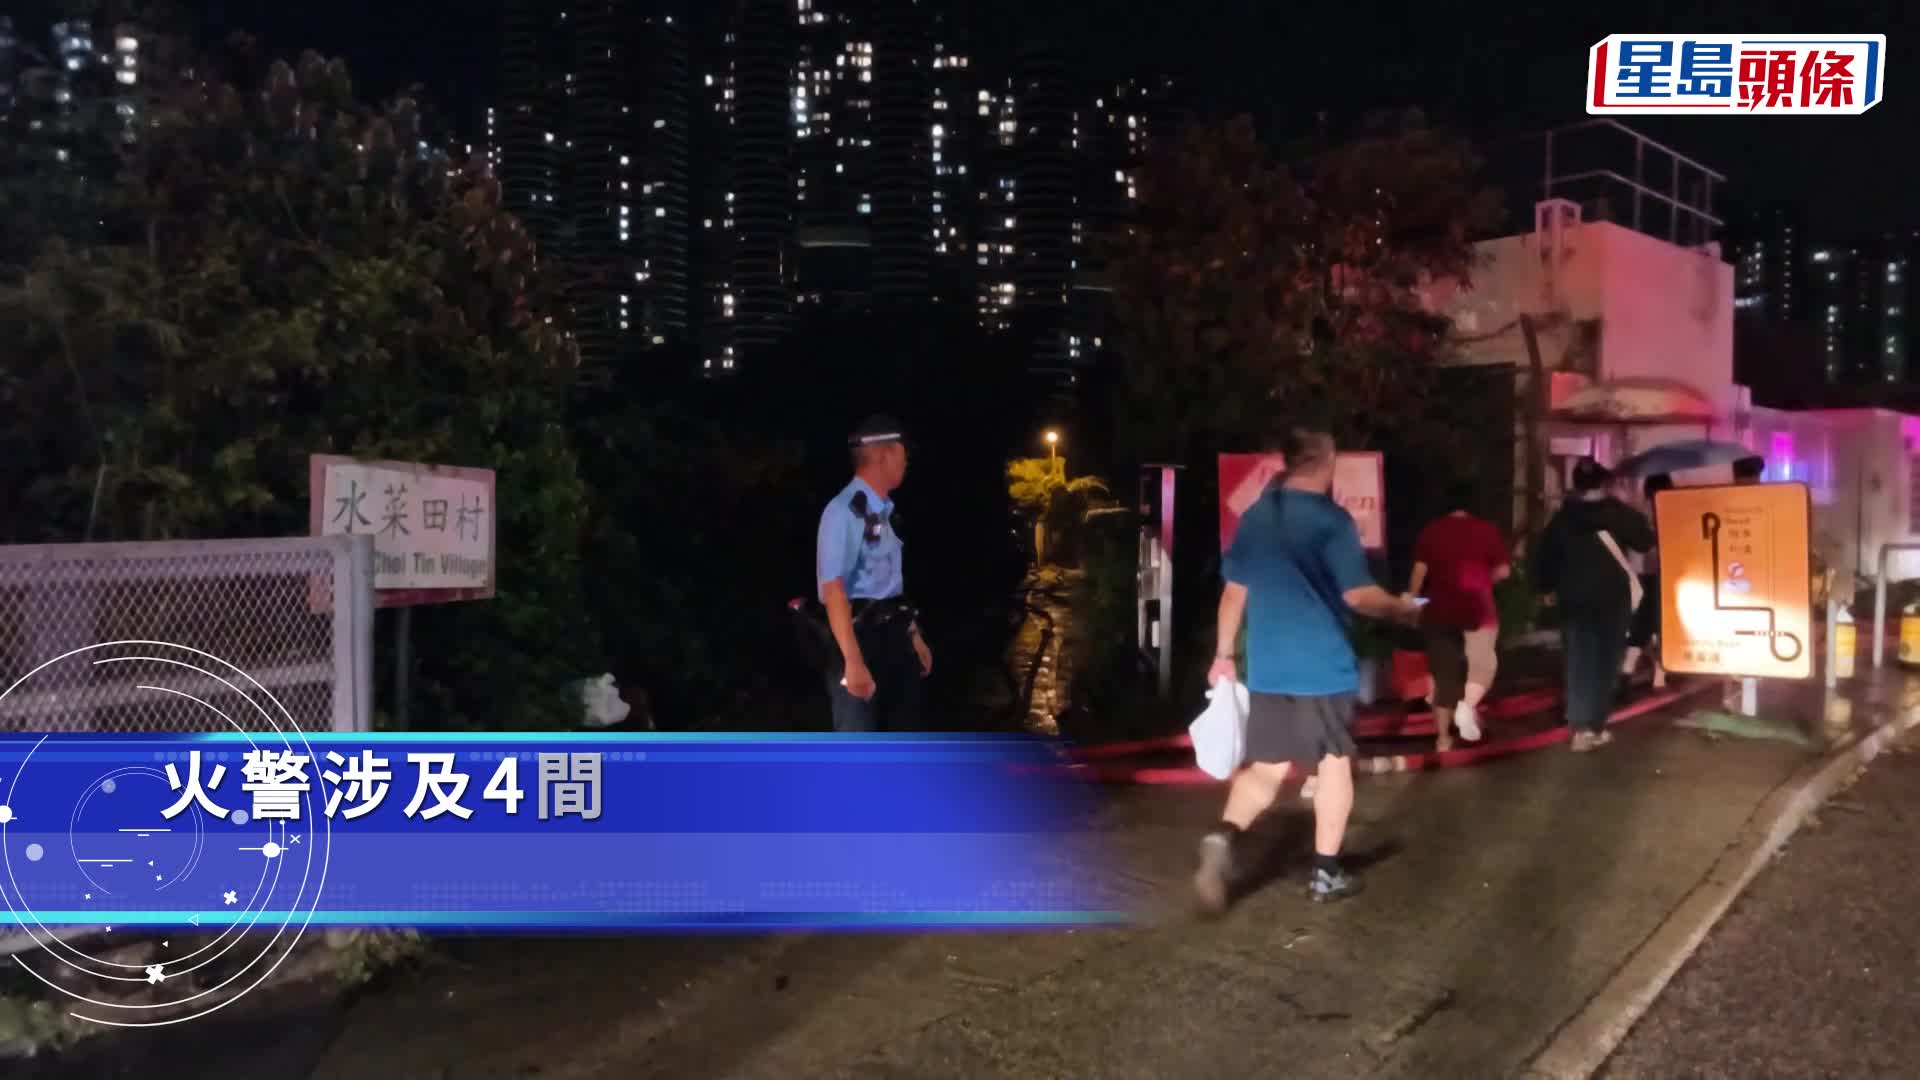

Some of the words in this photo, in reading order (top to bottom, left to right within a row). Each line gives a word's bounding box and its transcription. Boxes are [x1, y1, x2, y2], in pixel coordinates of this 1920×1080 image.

[331, 479, 484, 543] 水菜田村
[413, 551, 436, 575] Tin
